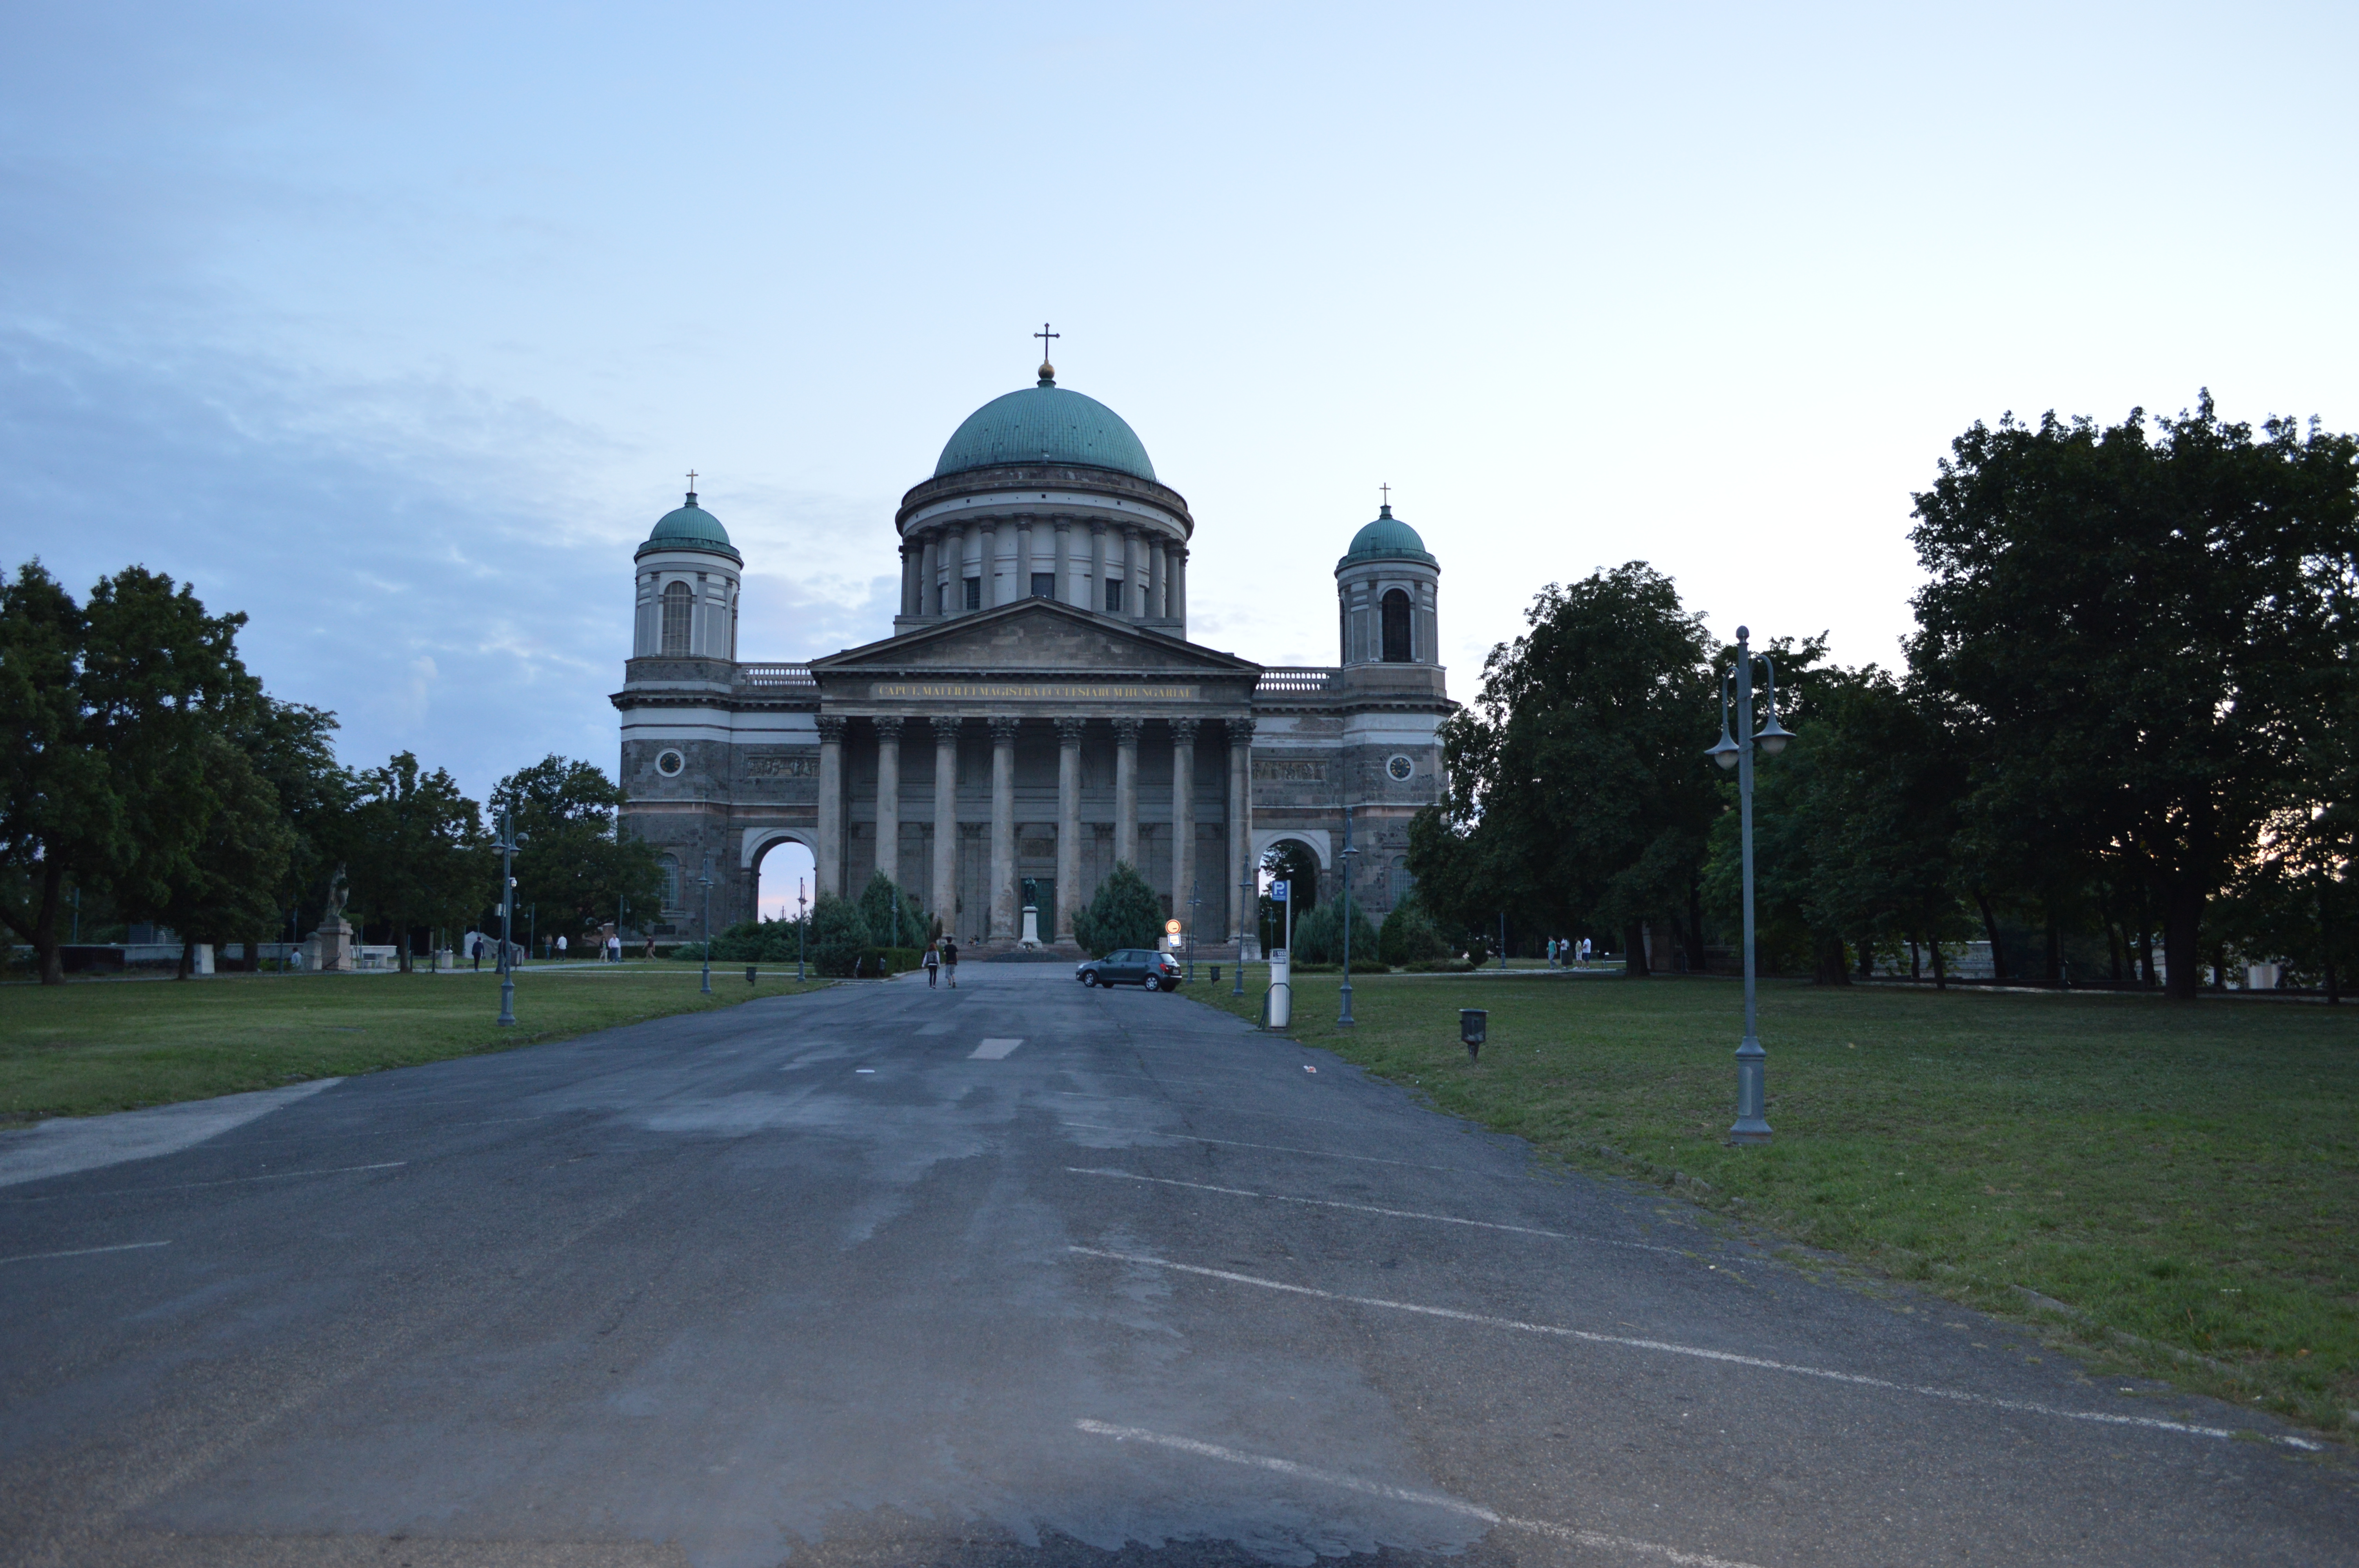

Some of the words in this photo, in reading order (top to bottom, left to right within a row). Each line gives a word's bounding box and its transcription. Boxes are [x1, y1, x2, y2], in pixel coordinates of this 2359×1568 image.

[923, 686, 961, 695] MATER
[964, 687, 976, 696] ET
[980, 687, 1038, 696] MAGISTRA
[1042, 687, 1122, 697] ECCLESIARUM
[1126, 688, 1191, 697] HUNGARIAE
[1274, 882, 1285, 895] P
